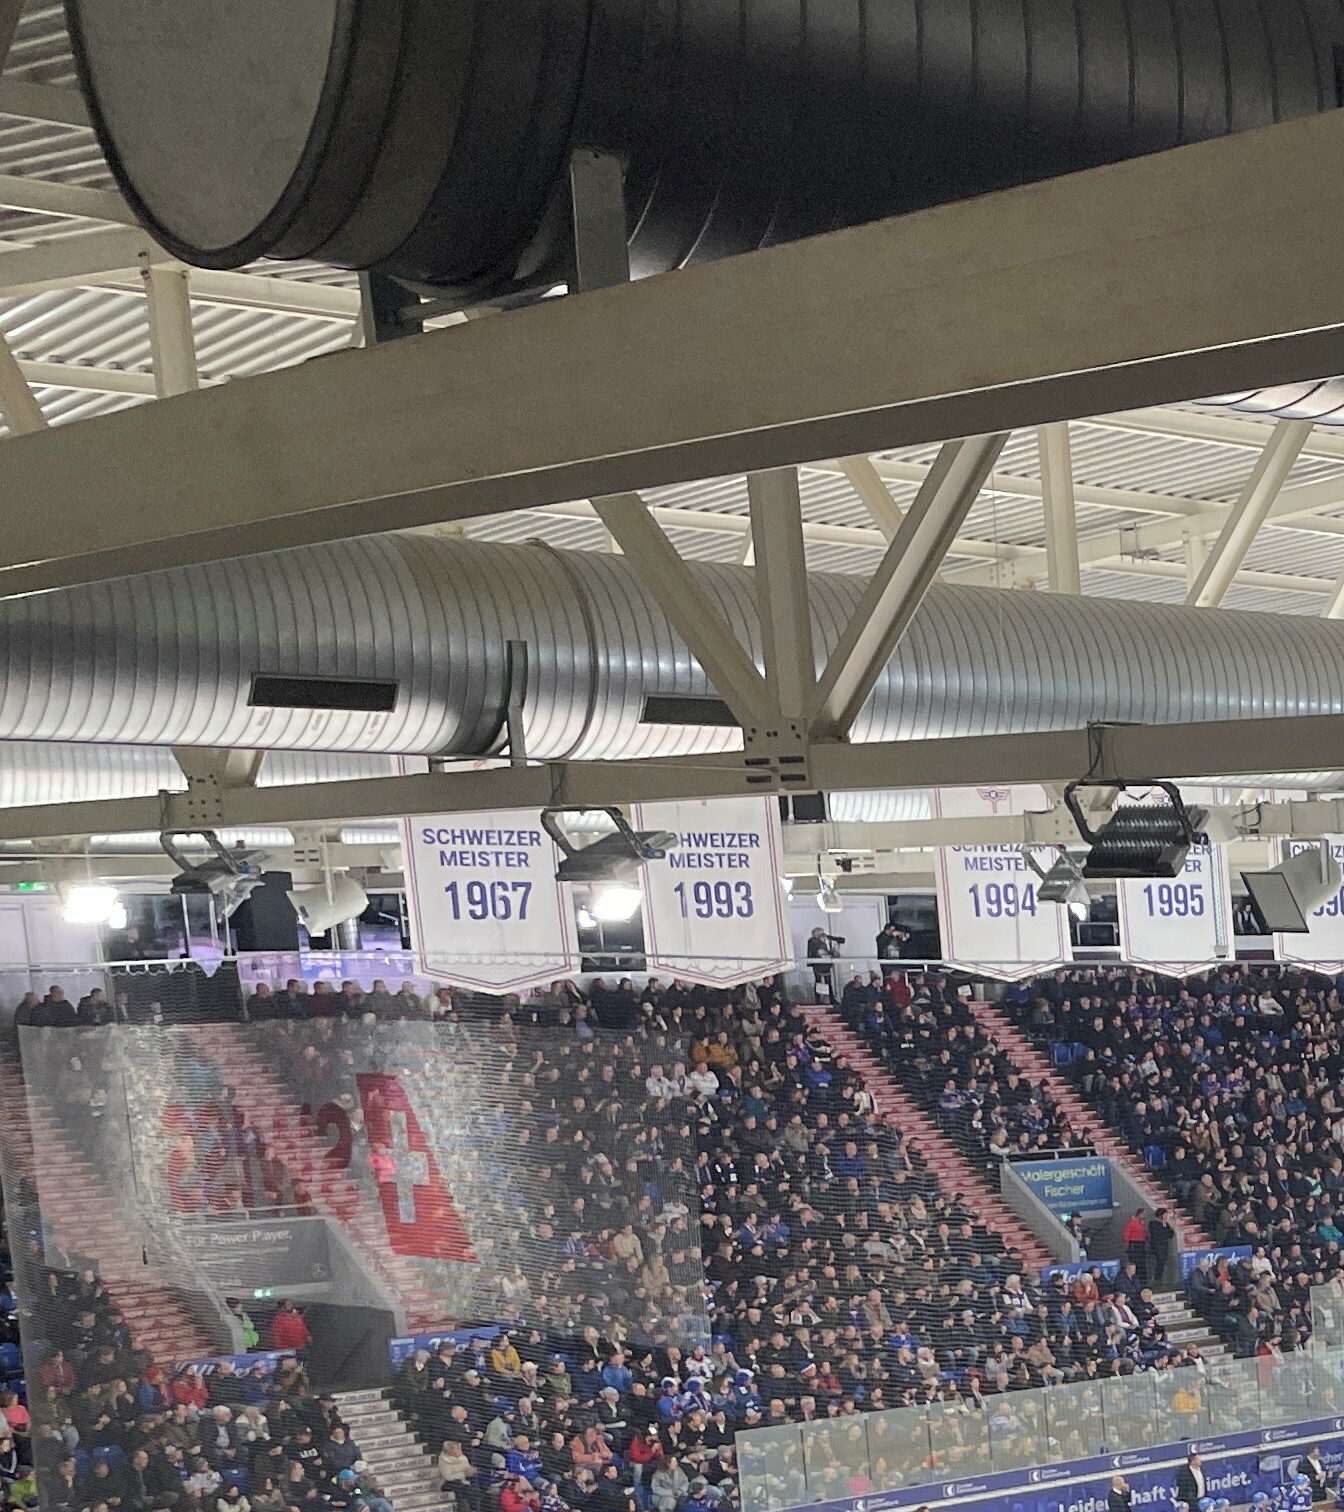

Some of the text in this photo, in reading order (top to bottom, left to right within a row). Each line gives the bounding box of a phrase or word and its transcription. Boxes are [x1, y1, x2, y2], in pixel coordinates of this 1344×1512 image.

[422, 828, 541, 847] SCHWEIZER
[679, 832, 760, 849] HWEIZER
[439, 851, 529, 868] MEISTER
[669, 853, 750, 868] MEISTER
[444, 881, 532, 920] 1967
[674, 881, 753, 918] 1993
[969, 883, 1037, 917] 1994
[1143, 884, 1204, 917] 1995
[1044, 1183, 1085, 1198] Fischer
[211, 1230, 249, 1243] Power
